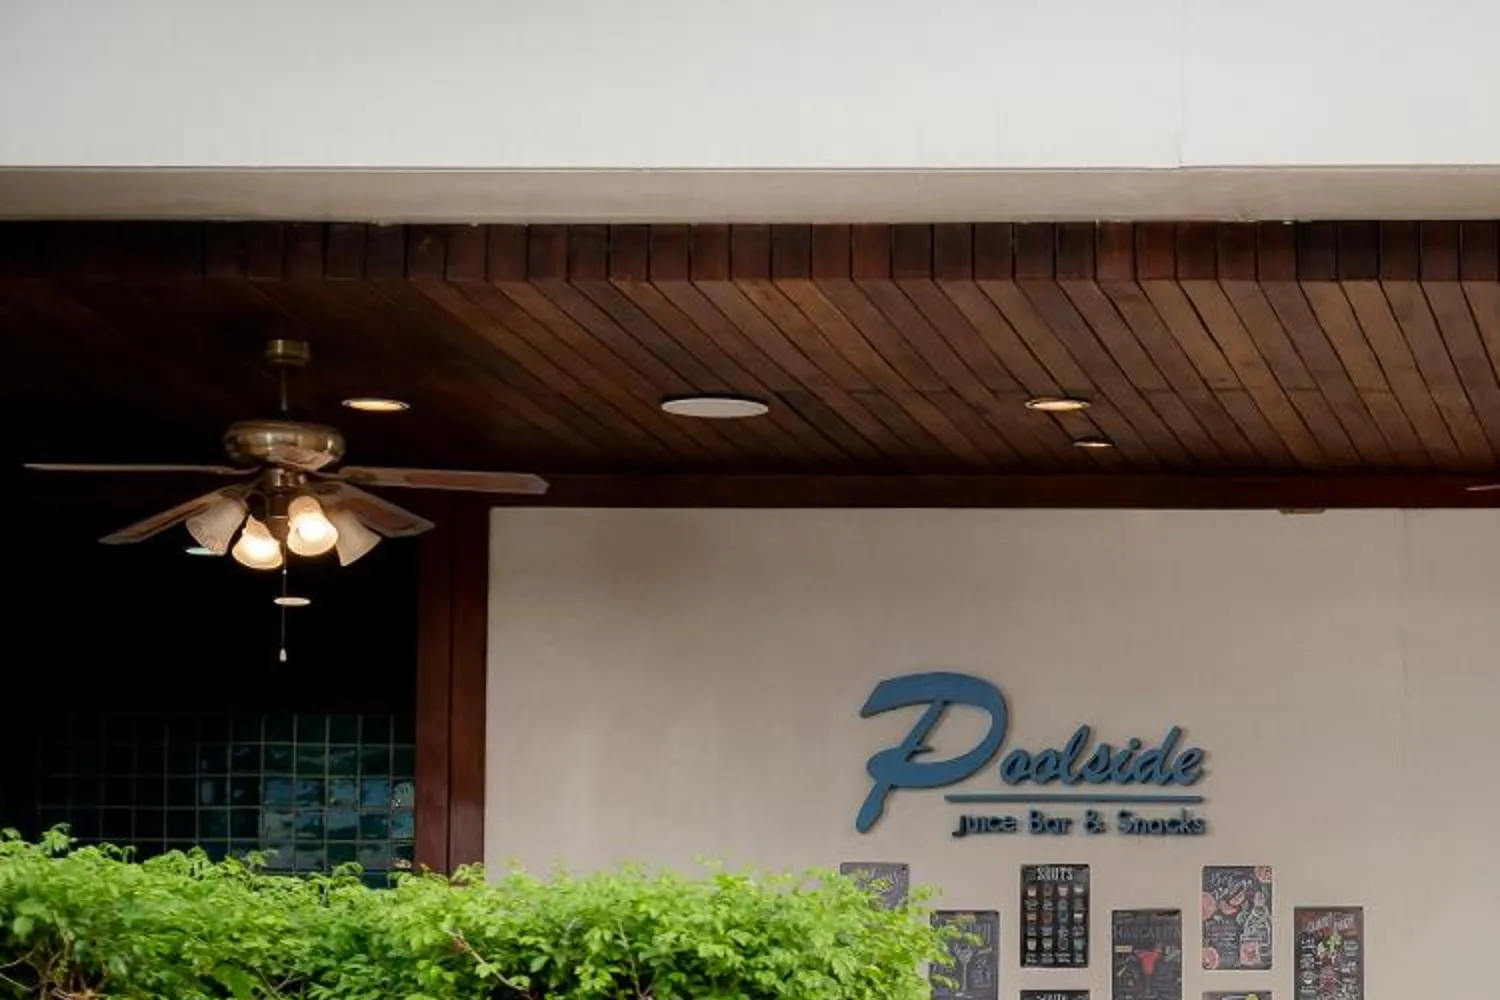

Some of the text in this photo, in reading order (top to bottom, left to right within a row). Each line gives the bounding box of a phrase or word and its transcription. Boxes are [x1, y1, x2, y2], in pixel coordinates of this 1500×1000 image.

[855, 671, 1207, 834] Poolside
[1029, 810, 1074, 835] Bar
[1084, 809, 1107, 834] &
[1117, 808, 1207, 835] Snacks
